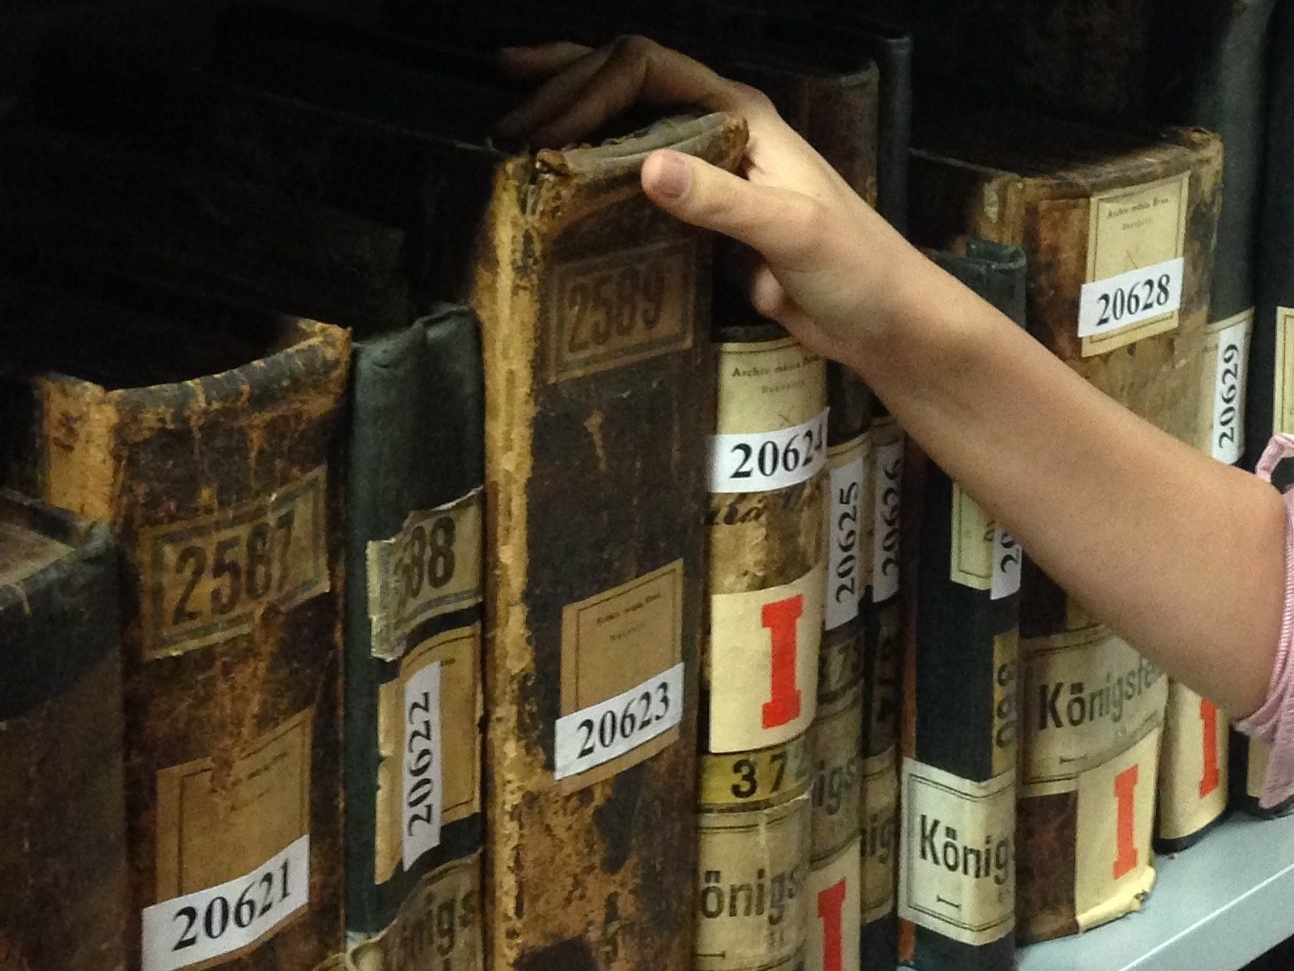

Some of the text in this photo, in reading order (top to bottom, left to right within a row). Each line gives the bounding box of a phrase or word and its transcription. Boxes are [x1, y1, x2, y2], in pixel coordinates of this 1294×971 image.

[1095, 272, 1171, 328] 20628
[1218, 342, 1240, 450] 20629
[835, 481, 859, 604] 20625
[407, 691, 433, 837] 20622
[576, 680, 671, 760] 20623
[918, 814, 1010, 886] König
[1114, 763, 1140, 881] I
[171, 858, 290, 953] 20621
